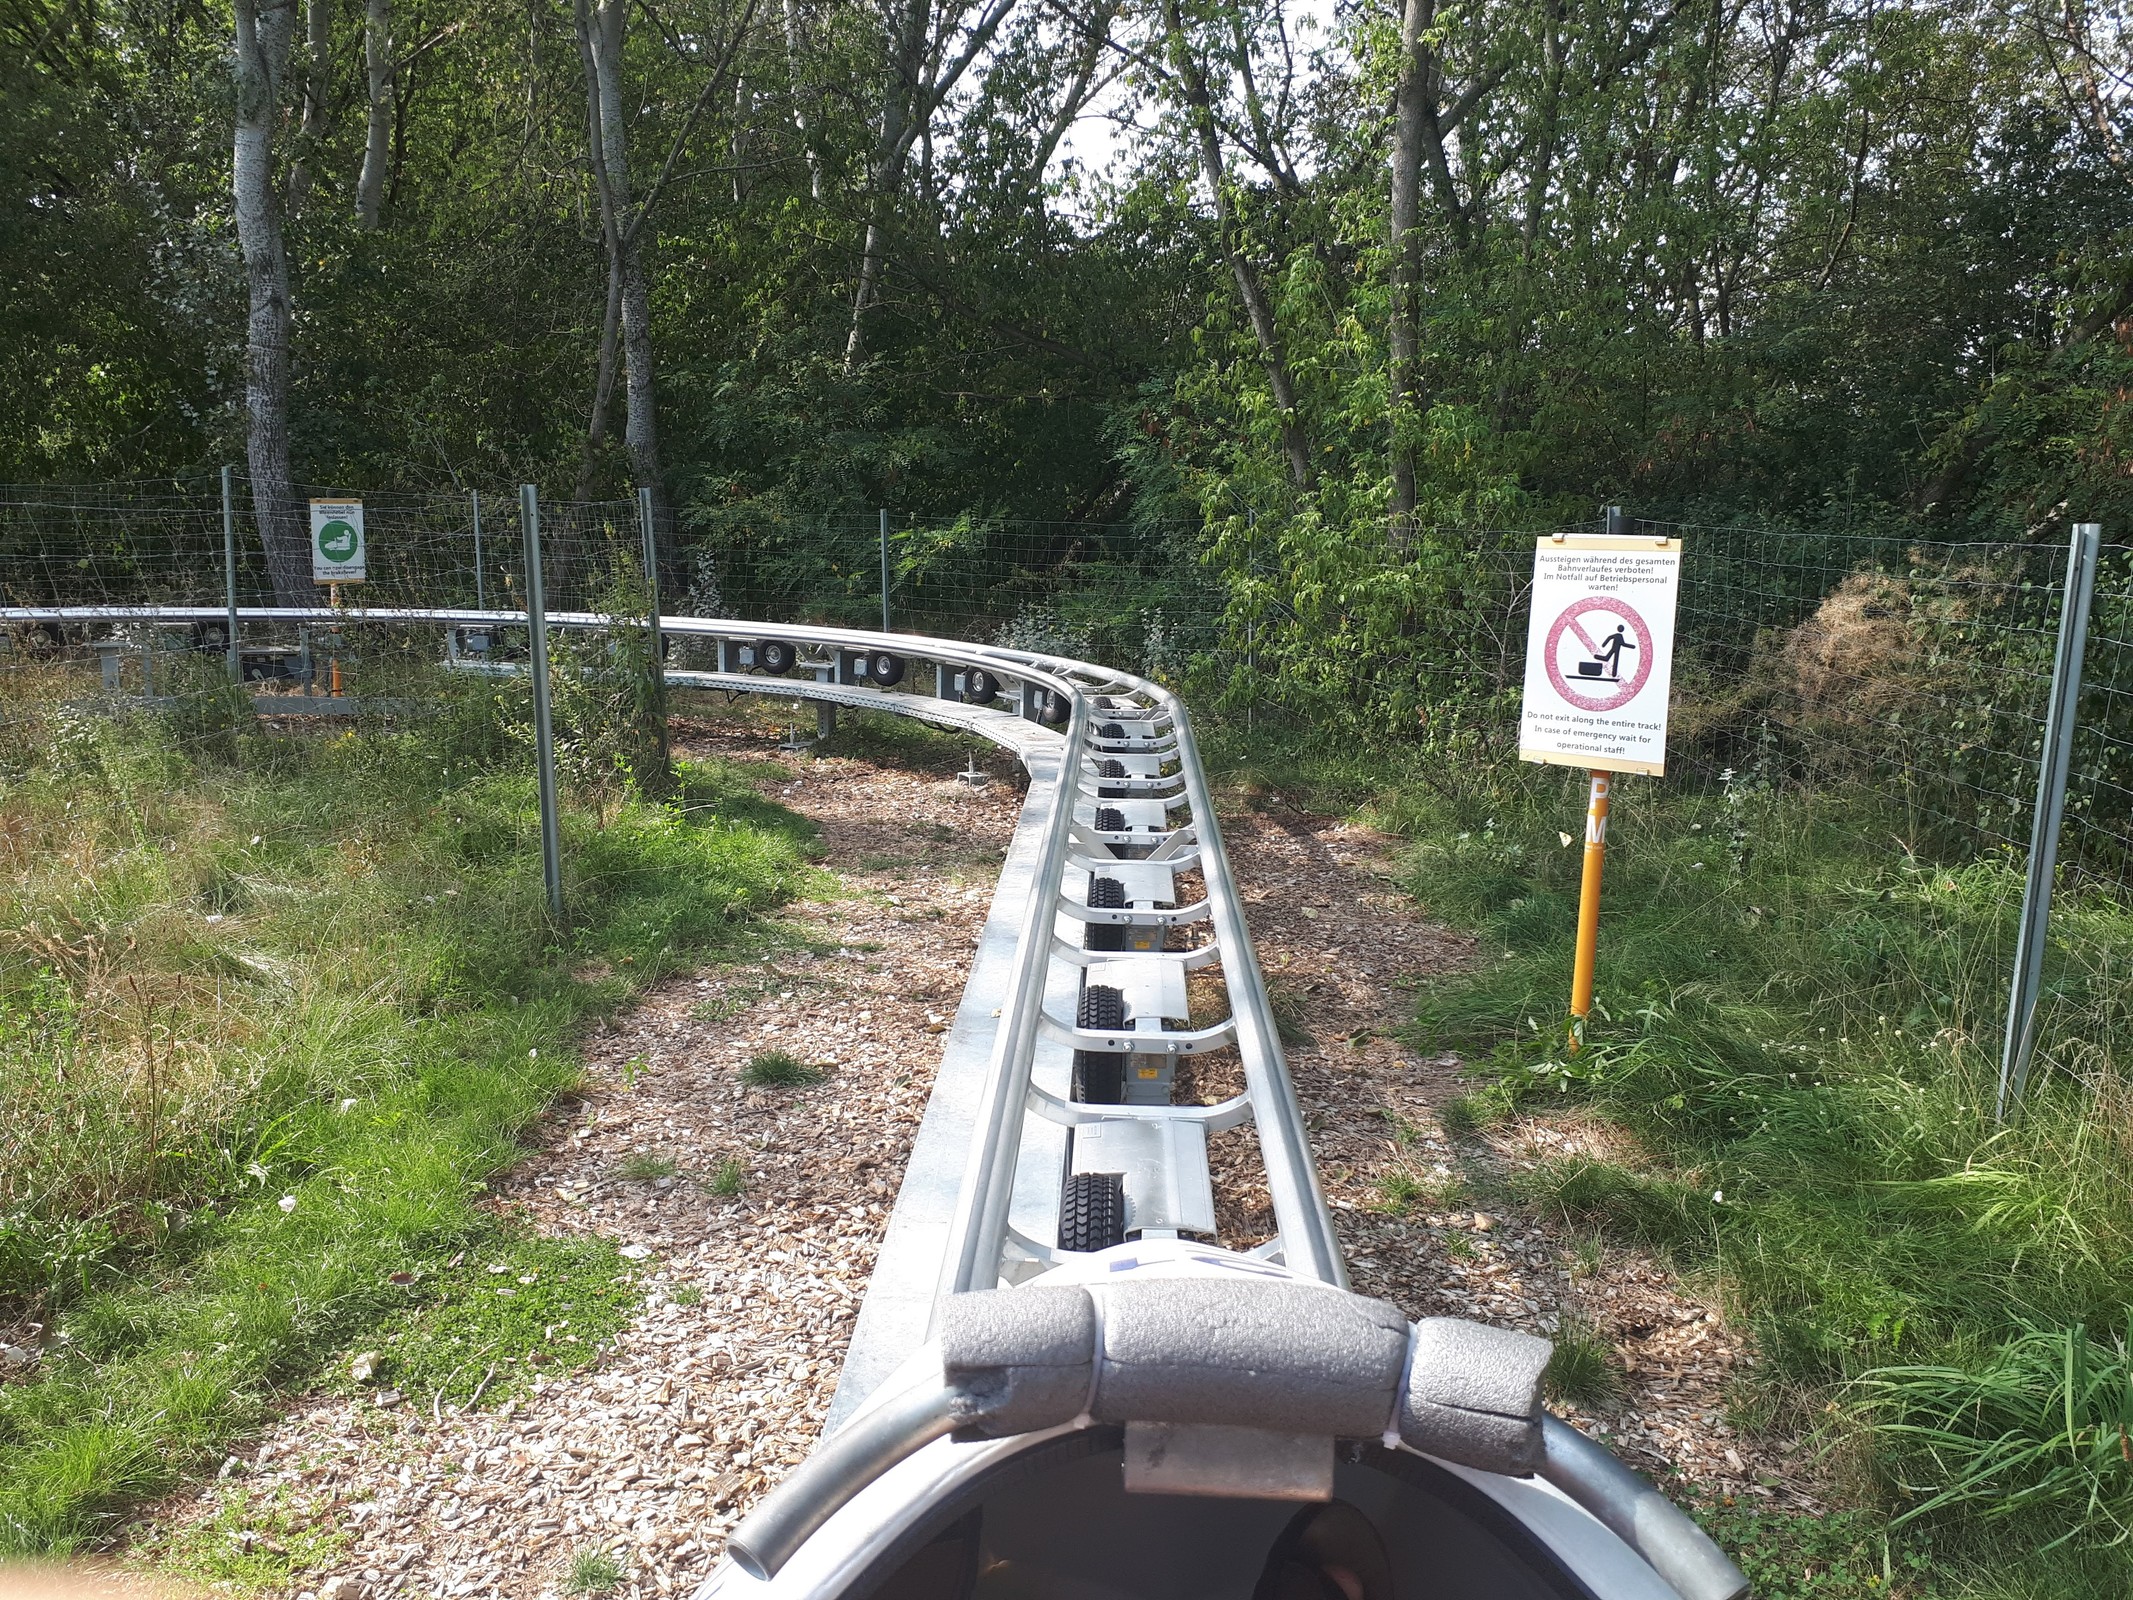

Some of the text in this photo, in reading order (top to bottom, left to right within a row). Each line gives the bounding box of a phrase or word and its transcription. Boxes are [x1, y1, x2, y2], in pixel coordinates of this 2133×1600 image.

[1539, 555, 1676, 566] Aussteigen während des gesamten
[1557, 564, 1654, 574] Bahnverlaufes verboten!
[1556, 573, 1583, 581] Notfall
[1585, 574, 1598, 582] auf
[1600, 574, 1668, 585] Betriebspersonal
[1588, 584, 1619, 592] warten!
[1527, 711, 1661, 731] Do not exit along the entire track!
[1544, 727, 1561, 735] case
[1573, 731, 1617, 742] emergency
[1619, 733, 1637, 742] wait
[1638, 735, 1651, 744] for
[1556, 741, 1625, 755] operational staff!
